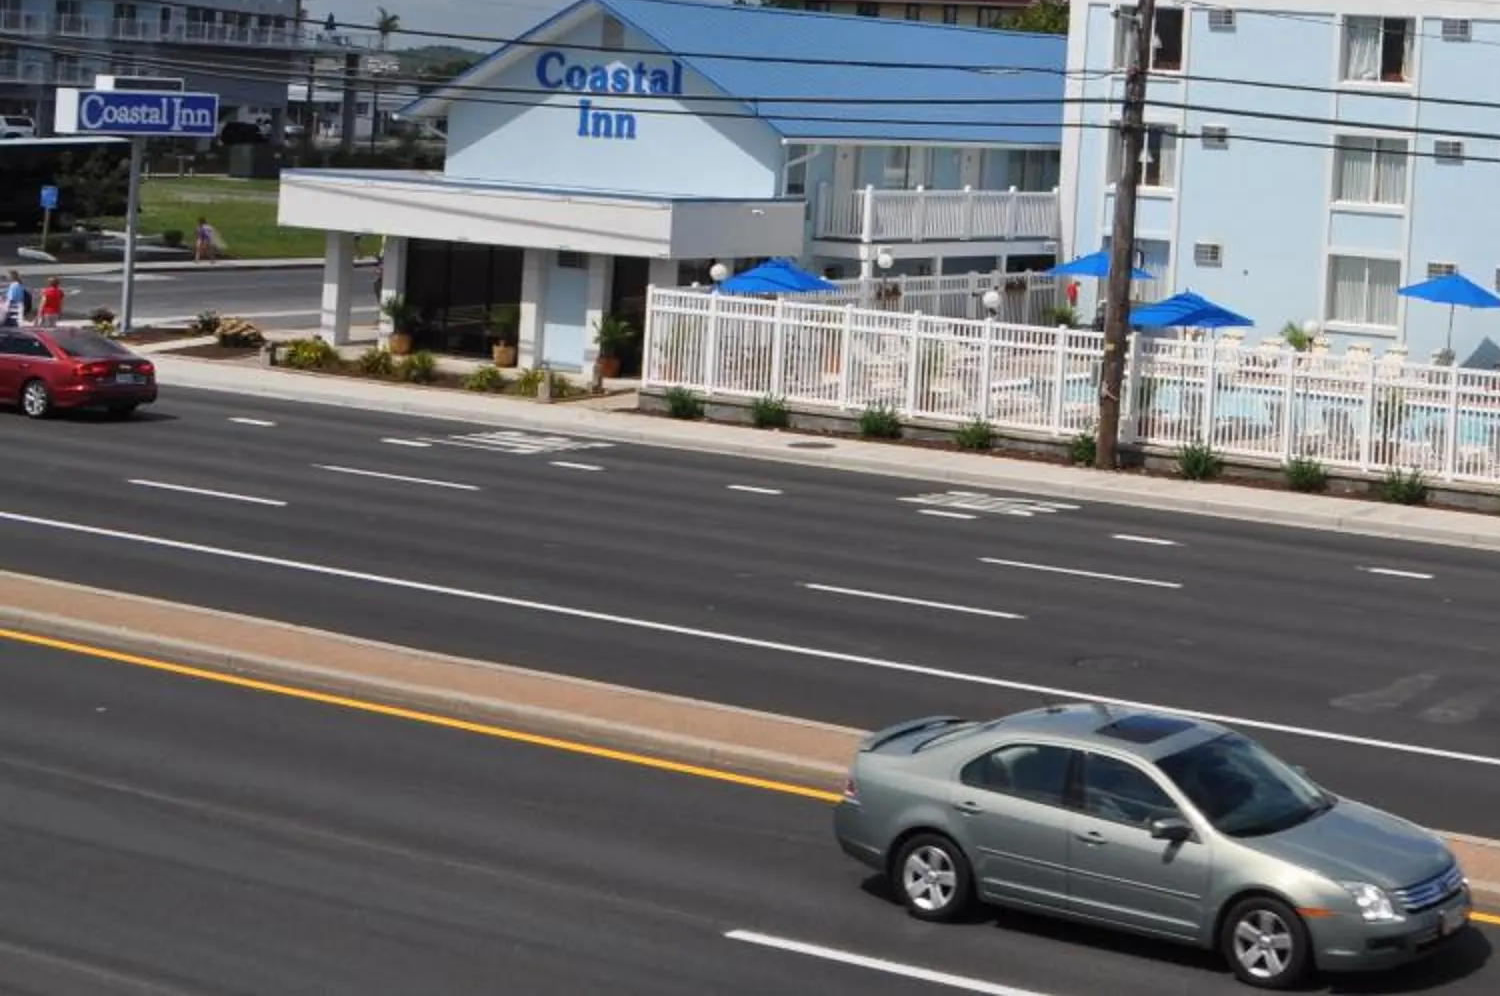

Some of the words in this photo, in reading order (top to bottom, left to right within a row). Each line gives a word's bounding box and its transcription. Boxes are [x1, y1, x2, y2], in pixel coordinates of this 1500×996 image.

[535, 51, 683, 94] Coastal
[80, 94, 169, 129] Coastal
[171, 97, 213, 132] Inn
[577, 98, 636, 139] Inn
